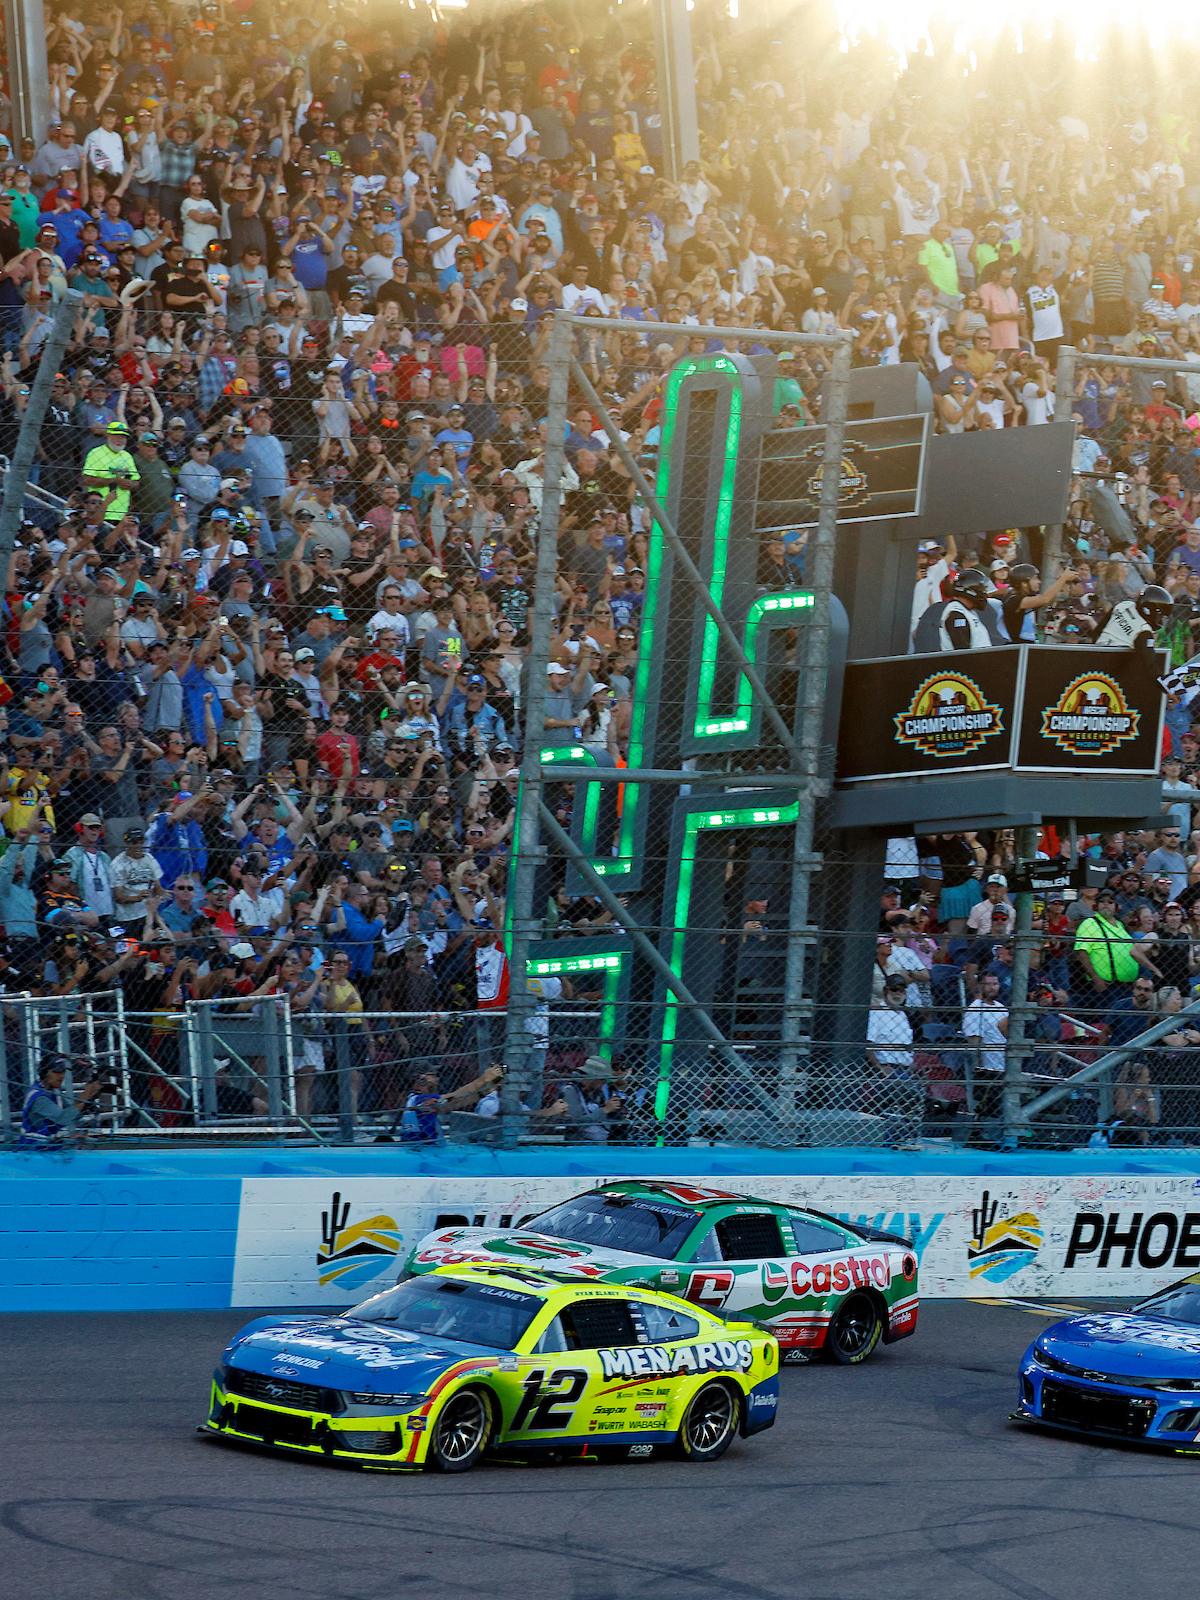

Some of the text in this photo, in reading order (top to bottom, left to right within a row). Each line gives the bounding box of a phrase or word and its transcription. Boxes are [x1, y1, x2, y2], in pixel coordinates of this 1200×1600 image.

[904, 714, 993, 735] CHAMPIONSHIP
[1050, 715, 1131, 732] CHAMPIONSHIP
[927, 732, 973, 742] WEEKEND
[631, 1202, 695, 1219] KESELOWSKI
[790, 1252, 891, 1296] Castrol
[479, 1287, 531, 1302] BLANEY
[597, 1340, 754, 1382] MENARDS
[510, 1367, 590, 1432] 12
[592, 1405, 627, 1416] Snap-on
[629, 1420, 666, 1429] WABASH
[628, 1445, 654, 1454] FORD
